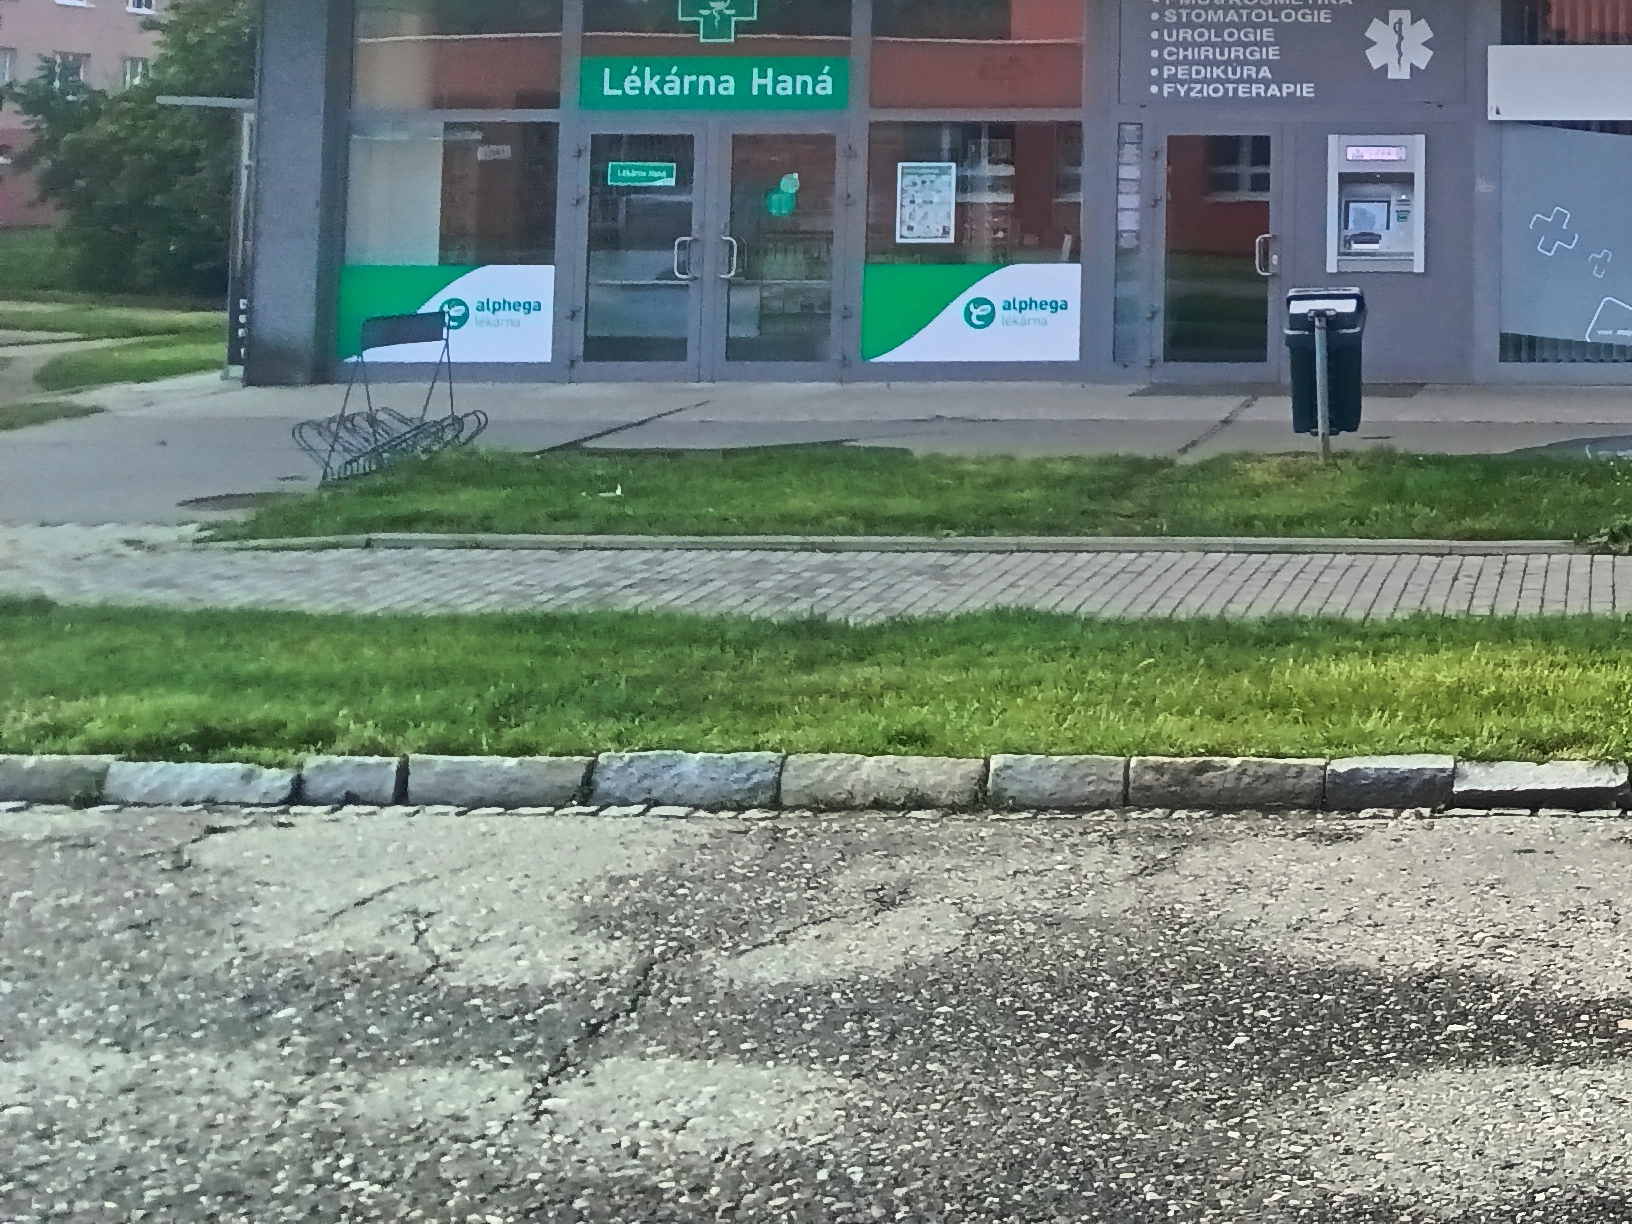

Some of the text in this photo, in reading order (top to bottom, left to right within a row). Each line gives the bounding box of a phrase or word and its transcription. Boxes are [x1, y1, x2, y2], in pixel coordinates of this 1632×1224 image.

[1164, 9, 1332, 23] STOMATOLOGIE
[1164, 27, 1275, 42] UROLOGIE
[1163, 46, 1281, 60] CHIRURGIE
[603, 65, 833, 95] Lékárna Haná
[1163, 82, 1315, 97] FYZIOTERAPIE
[475, 297, 542, 315] alphega
[1002, 296, 1069, 314] alphega
